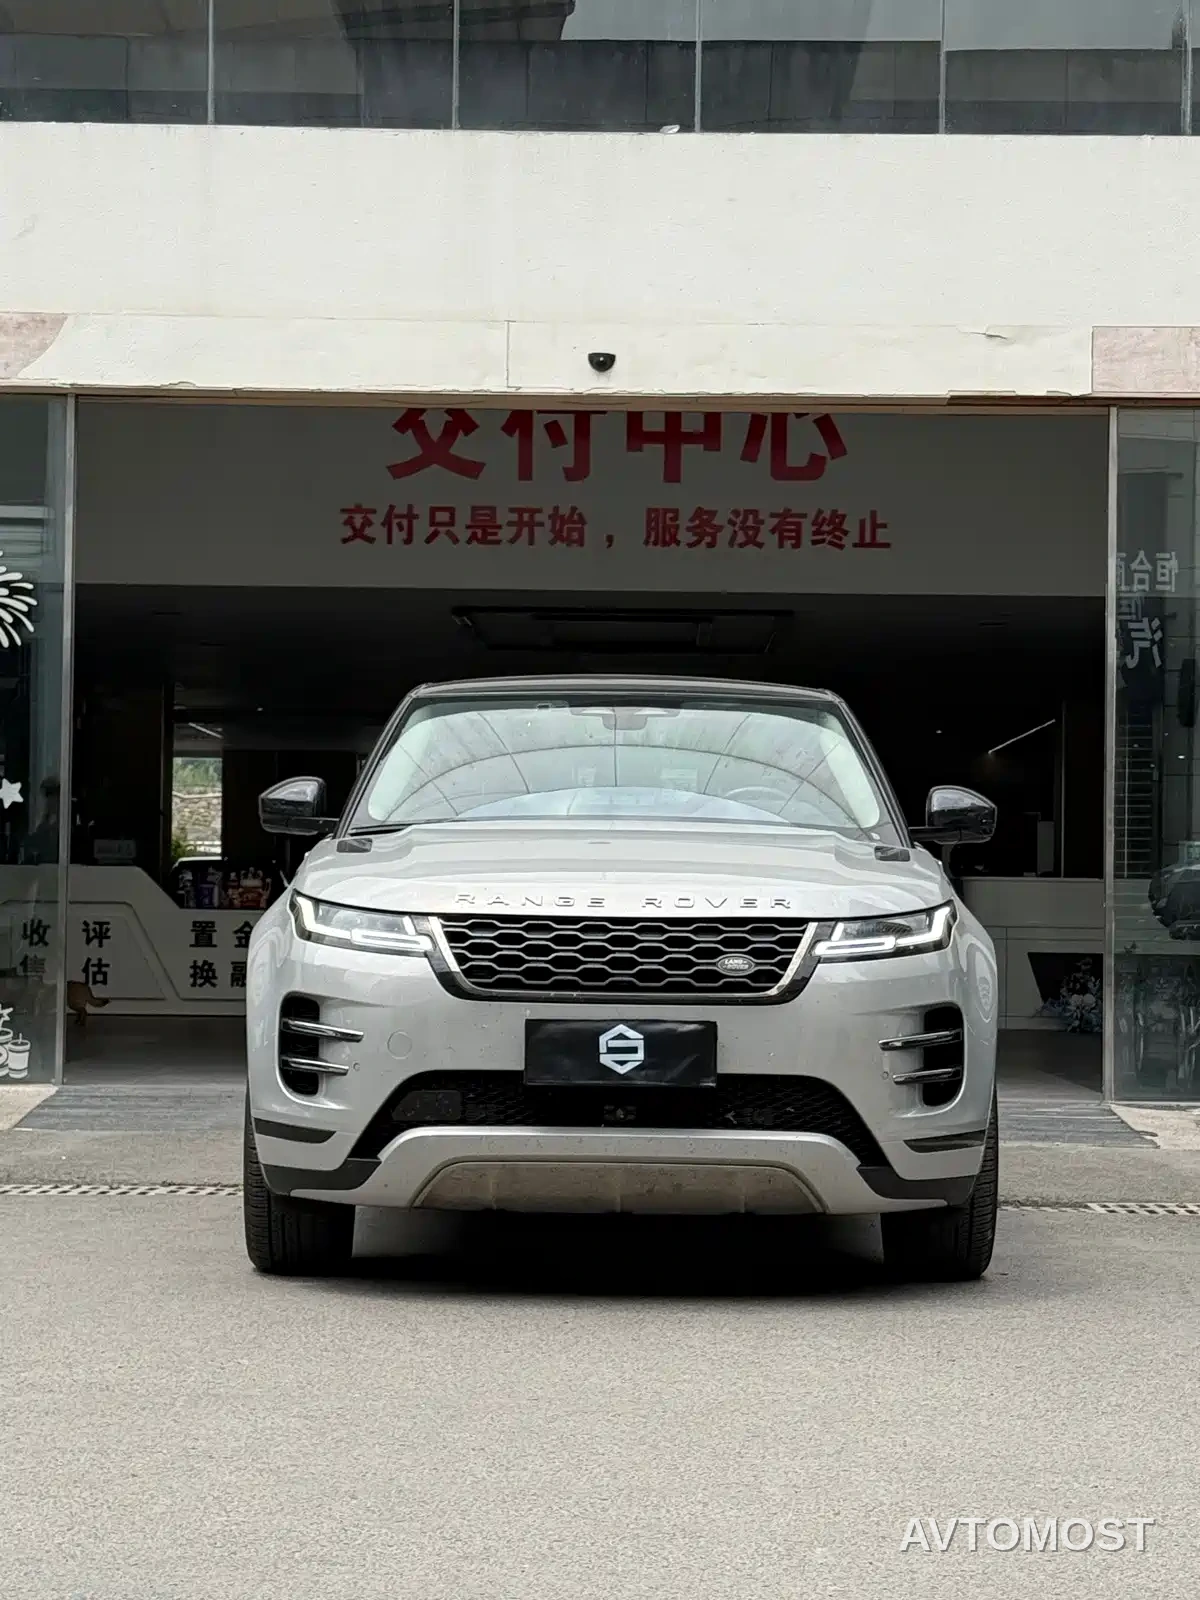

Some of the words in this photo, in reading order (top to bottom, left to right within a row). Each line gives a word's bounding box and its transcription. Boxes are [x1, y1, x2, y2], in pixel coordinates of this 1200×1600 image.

[386, 407, 848, 484] 交付中心
[453, 893, 605, 908] RANGE
[641, 895, 792, 910] ROVER
[82, 919, 112, 986] 评估
[189, 920, 219, 988] 置换
